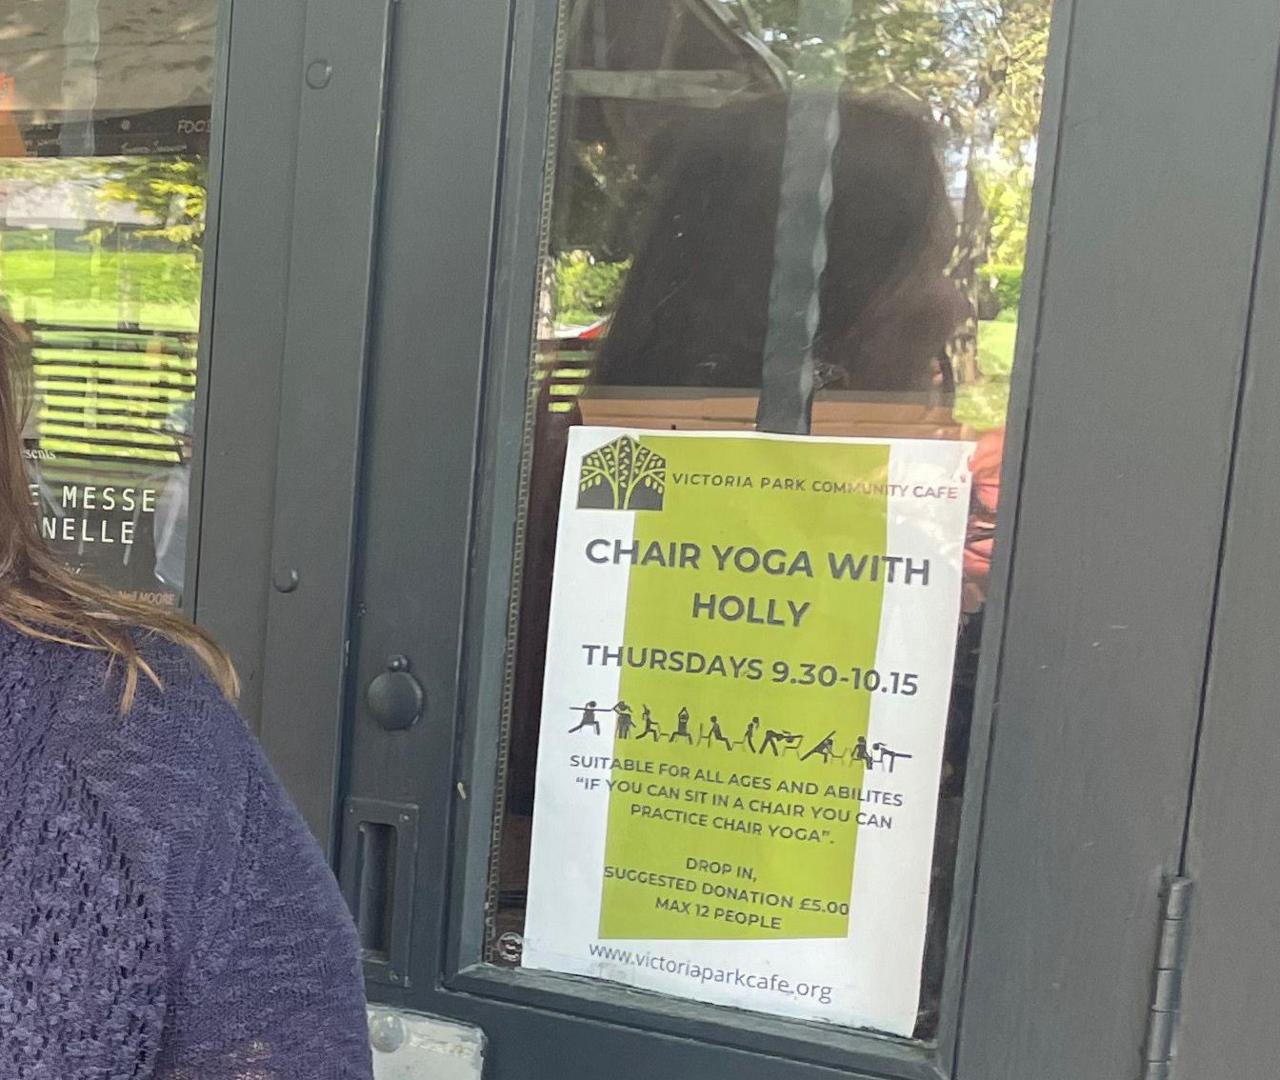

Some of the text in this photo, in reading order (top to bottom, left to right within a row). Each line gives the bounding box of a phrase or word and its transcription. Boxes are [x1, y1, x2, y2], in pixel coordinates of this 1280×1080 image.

[62, 485, 156, 512] MESSE
[672, 472, 959, 500] VICTORIA PARK COMMUNITY CAFE
[585, 538, 931, 587] CHAIR YOGA WITH
[692, 592, 811, 628] HOLLY
[582, 644, 919, 697] THURSDAYS 9.30-10.15
[570, 754, 904, 808] SUITABLE FOR ALL AGES AND ABILITES
[606, 779, 642, 795] YOU
[646, 784, 680, 801] CAN
[684, 788, 707, 804] SIT
[711, 791, 730, 807] IN
[733, 794, 745, 810] A
[748, 797, 806, 819] CHAIR
[810, 803, 851, 823] YOU
[855, 810, 893, 830] CAN
[631, 803, 709, 829] PRACTICE
[712, 814, 764, 836] CHAIR
[604, 865, 850, 916] SUGGESTED DONATION £5.00
[686, 857, 758, 882] DROP IN,
[655, 897, 782, 931] MAX 12 PEOPLE
[588, 942, 833, 1004] www.victoriaparkcafe.org
